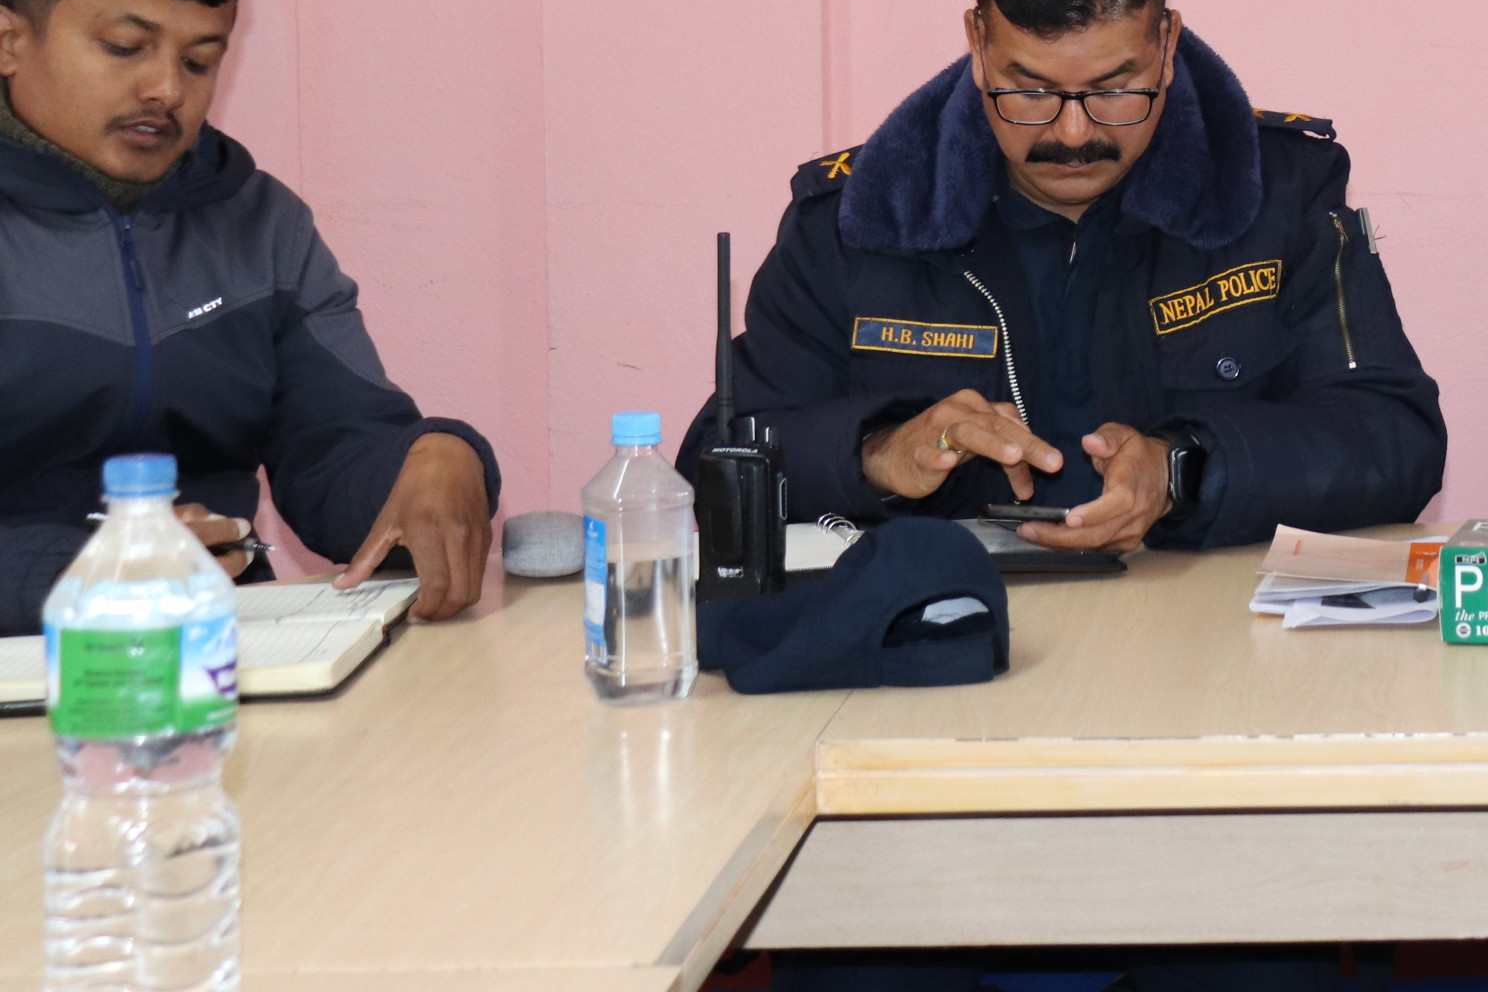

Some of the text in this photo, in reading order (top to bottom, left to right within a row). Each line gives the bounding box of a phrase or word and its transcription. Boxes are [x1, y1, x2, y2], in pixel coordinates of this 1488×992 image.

[1159, 267, 1276, 324] NEPAL POLICE
[881, 326, 975, 349] H.B. SHAHI
[1455, 609, 1475, 621] the
